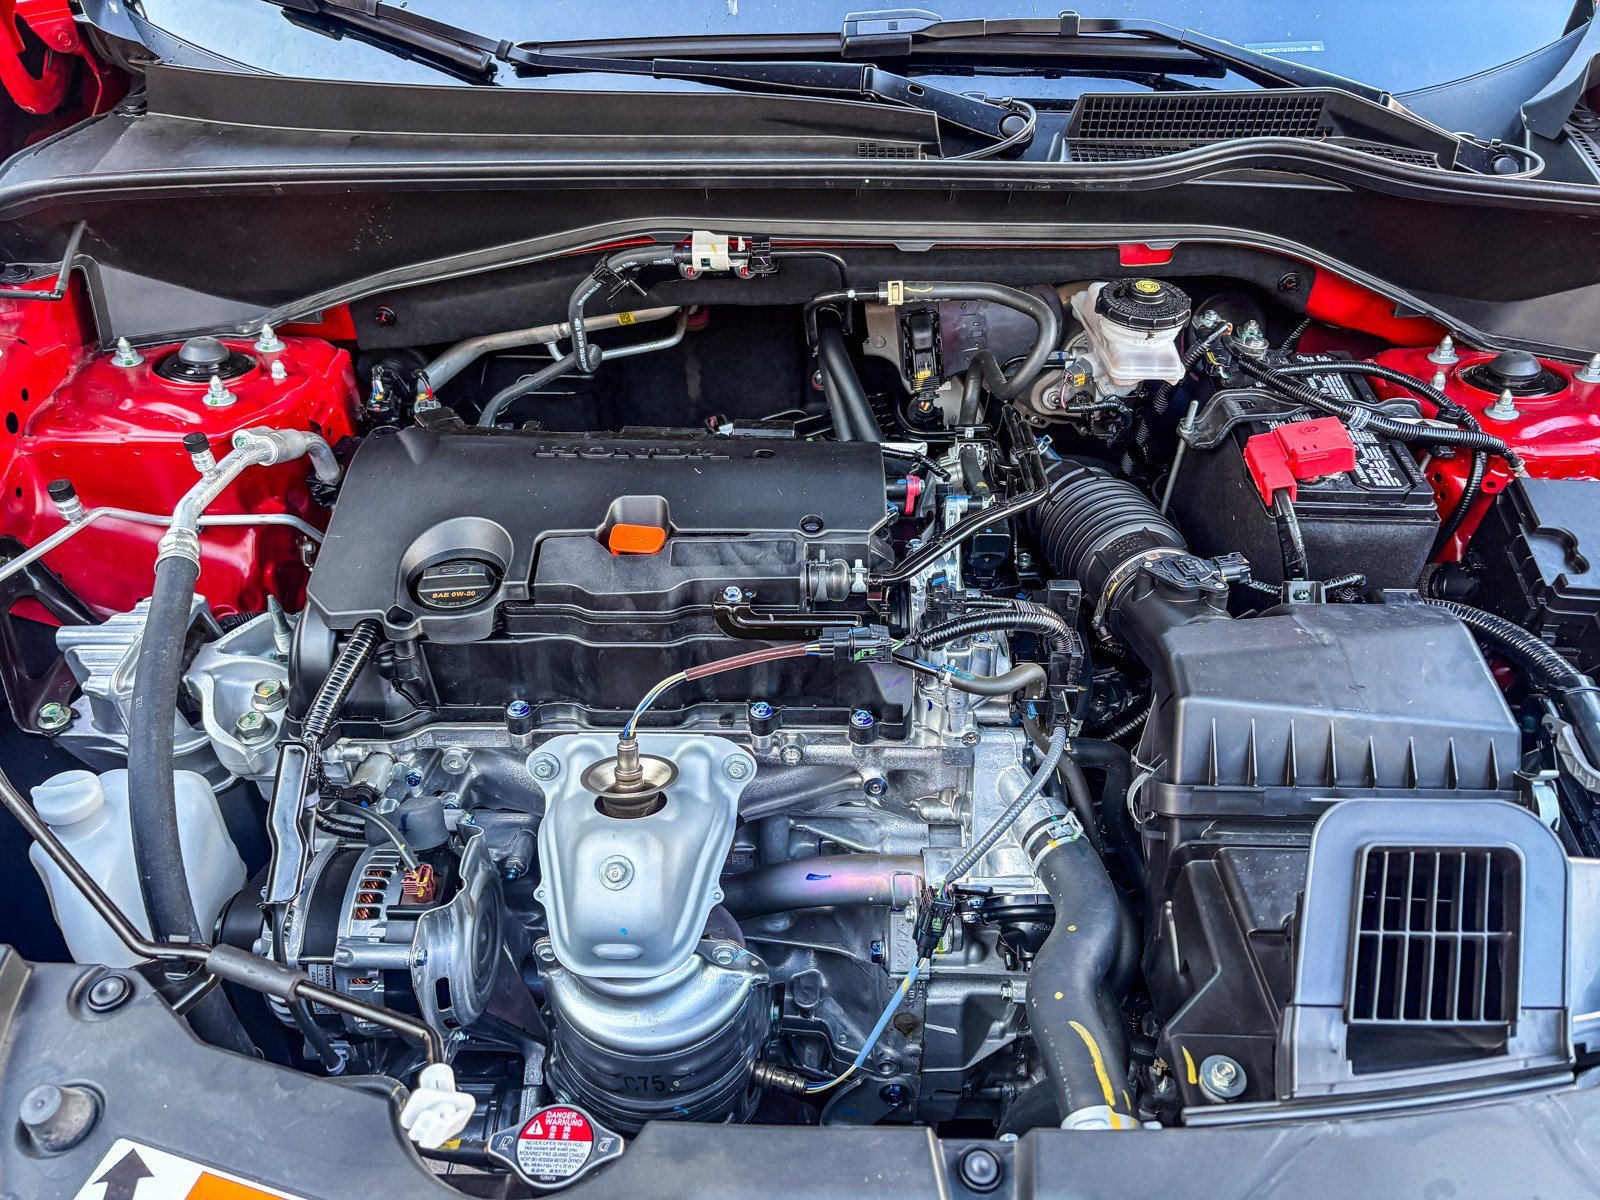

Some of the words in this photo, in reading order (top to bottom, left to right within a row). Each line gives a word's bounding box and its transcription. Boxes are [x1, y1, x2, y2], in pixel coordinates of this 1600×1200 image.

[532, 445, 732, 460] HONDA
[451, 590, 476, 598] 0W-20
[546, 1111, 577, 1120] DANGER
[545, 1118, 583, 1127] WARNUNG
